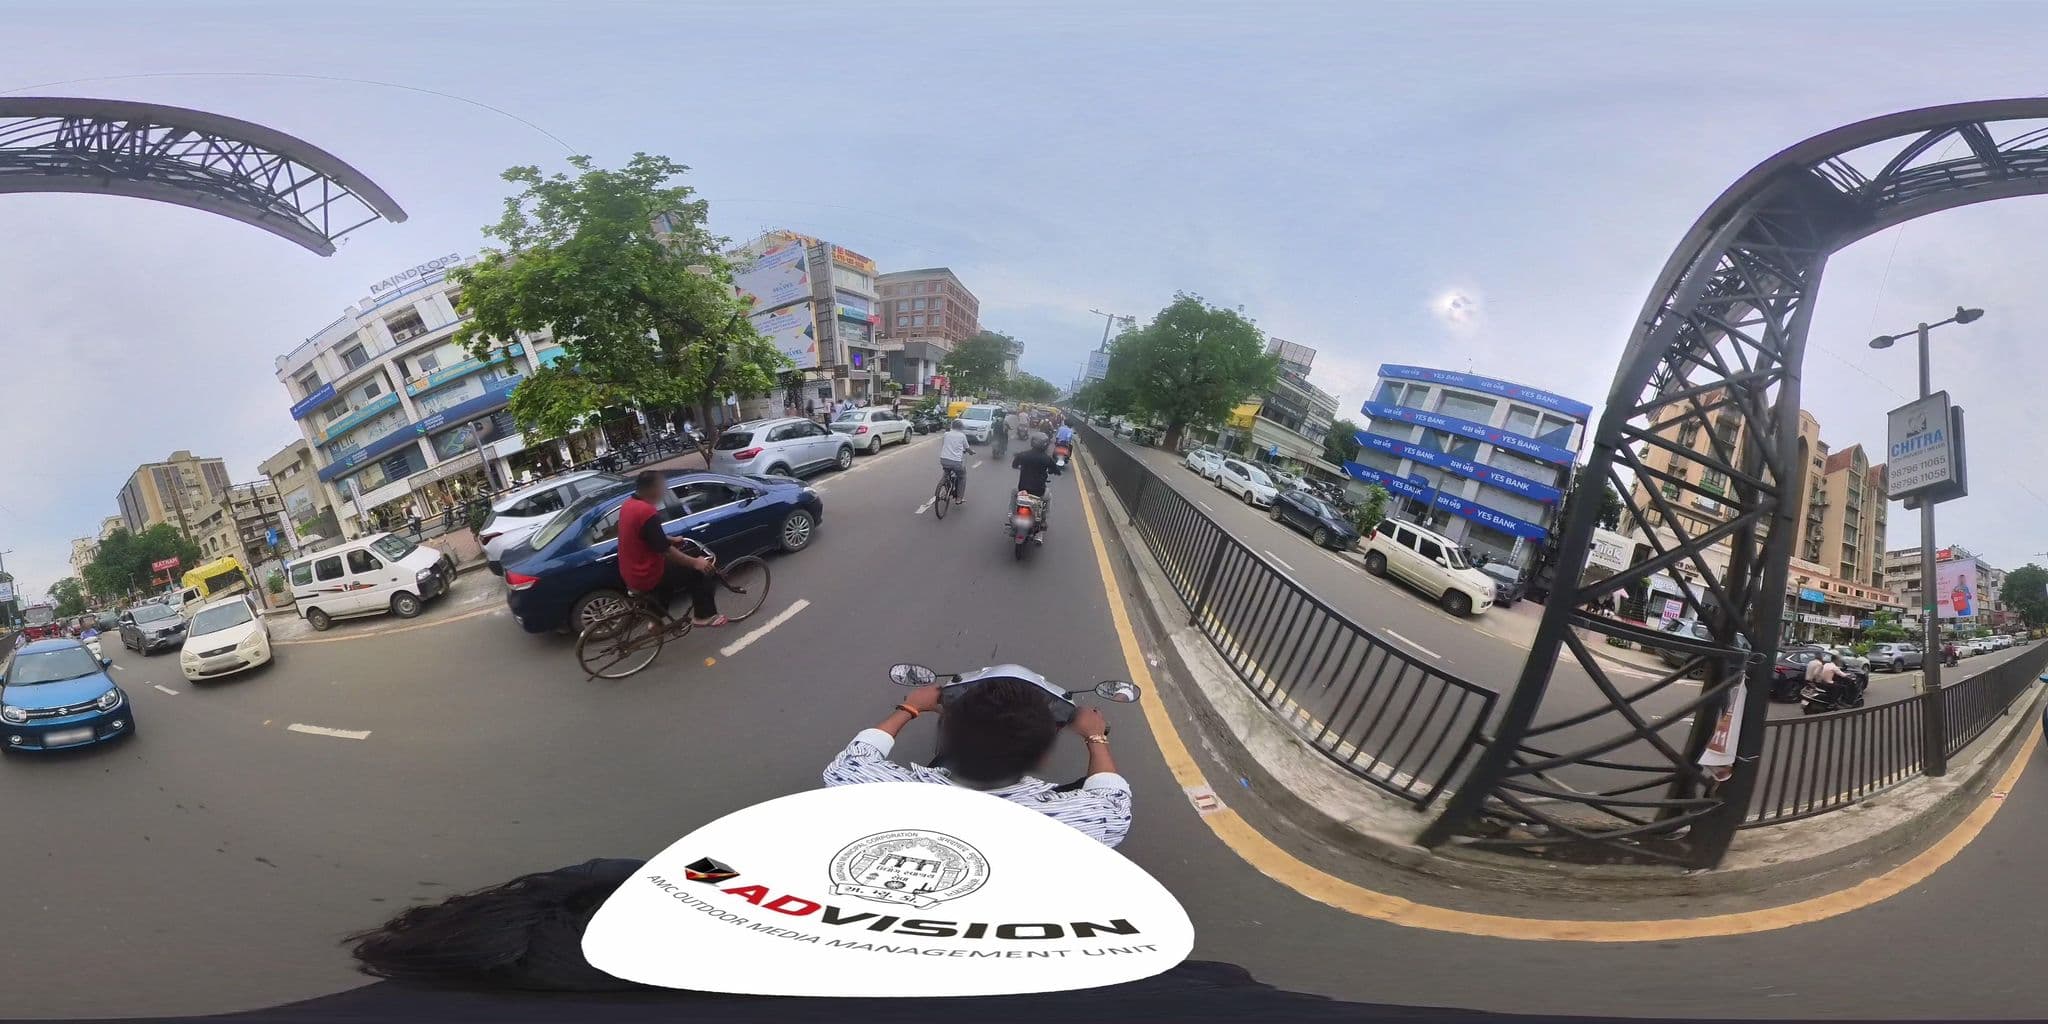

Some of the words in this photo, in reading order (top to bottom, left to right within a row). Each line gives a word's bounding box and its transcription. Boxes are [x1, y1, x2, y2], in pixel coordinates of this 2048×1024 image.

[370, 252, 460, 294] RAINDROPS
[1433, 372, 1448, 380] YES
[1520, 389, 1535, 399] YES
[1536, 393, 1559, 405] BANK
[1415, 413, 1426, 421] YES
[1426, 415, 1446, 426] BANK
[1501, 434, 1516, 445] YES
[1517, 439, 1541, 452] BANK
[1891, 429, 1944, 457] CHITRA
[1404, 446, 1416, 456] YES
[1416, 449, 1435, 461] BANK
[1890, 464, 1918, 479] 98796
[1920, 457, 1946, 469] 11065
[1392, 480, 1404, 490] YES
[1490, 472, 1505, 483] YES
[1505, 476, 1530, 492] BANK
[1890, 476, 1918, 490] 98796
[1920, 468, 1946, 480] 11058
[1477, 510, 1492, 522] YES
[1492, 516, 1517, 530] BANK
